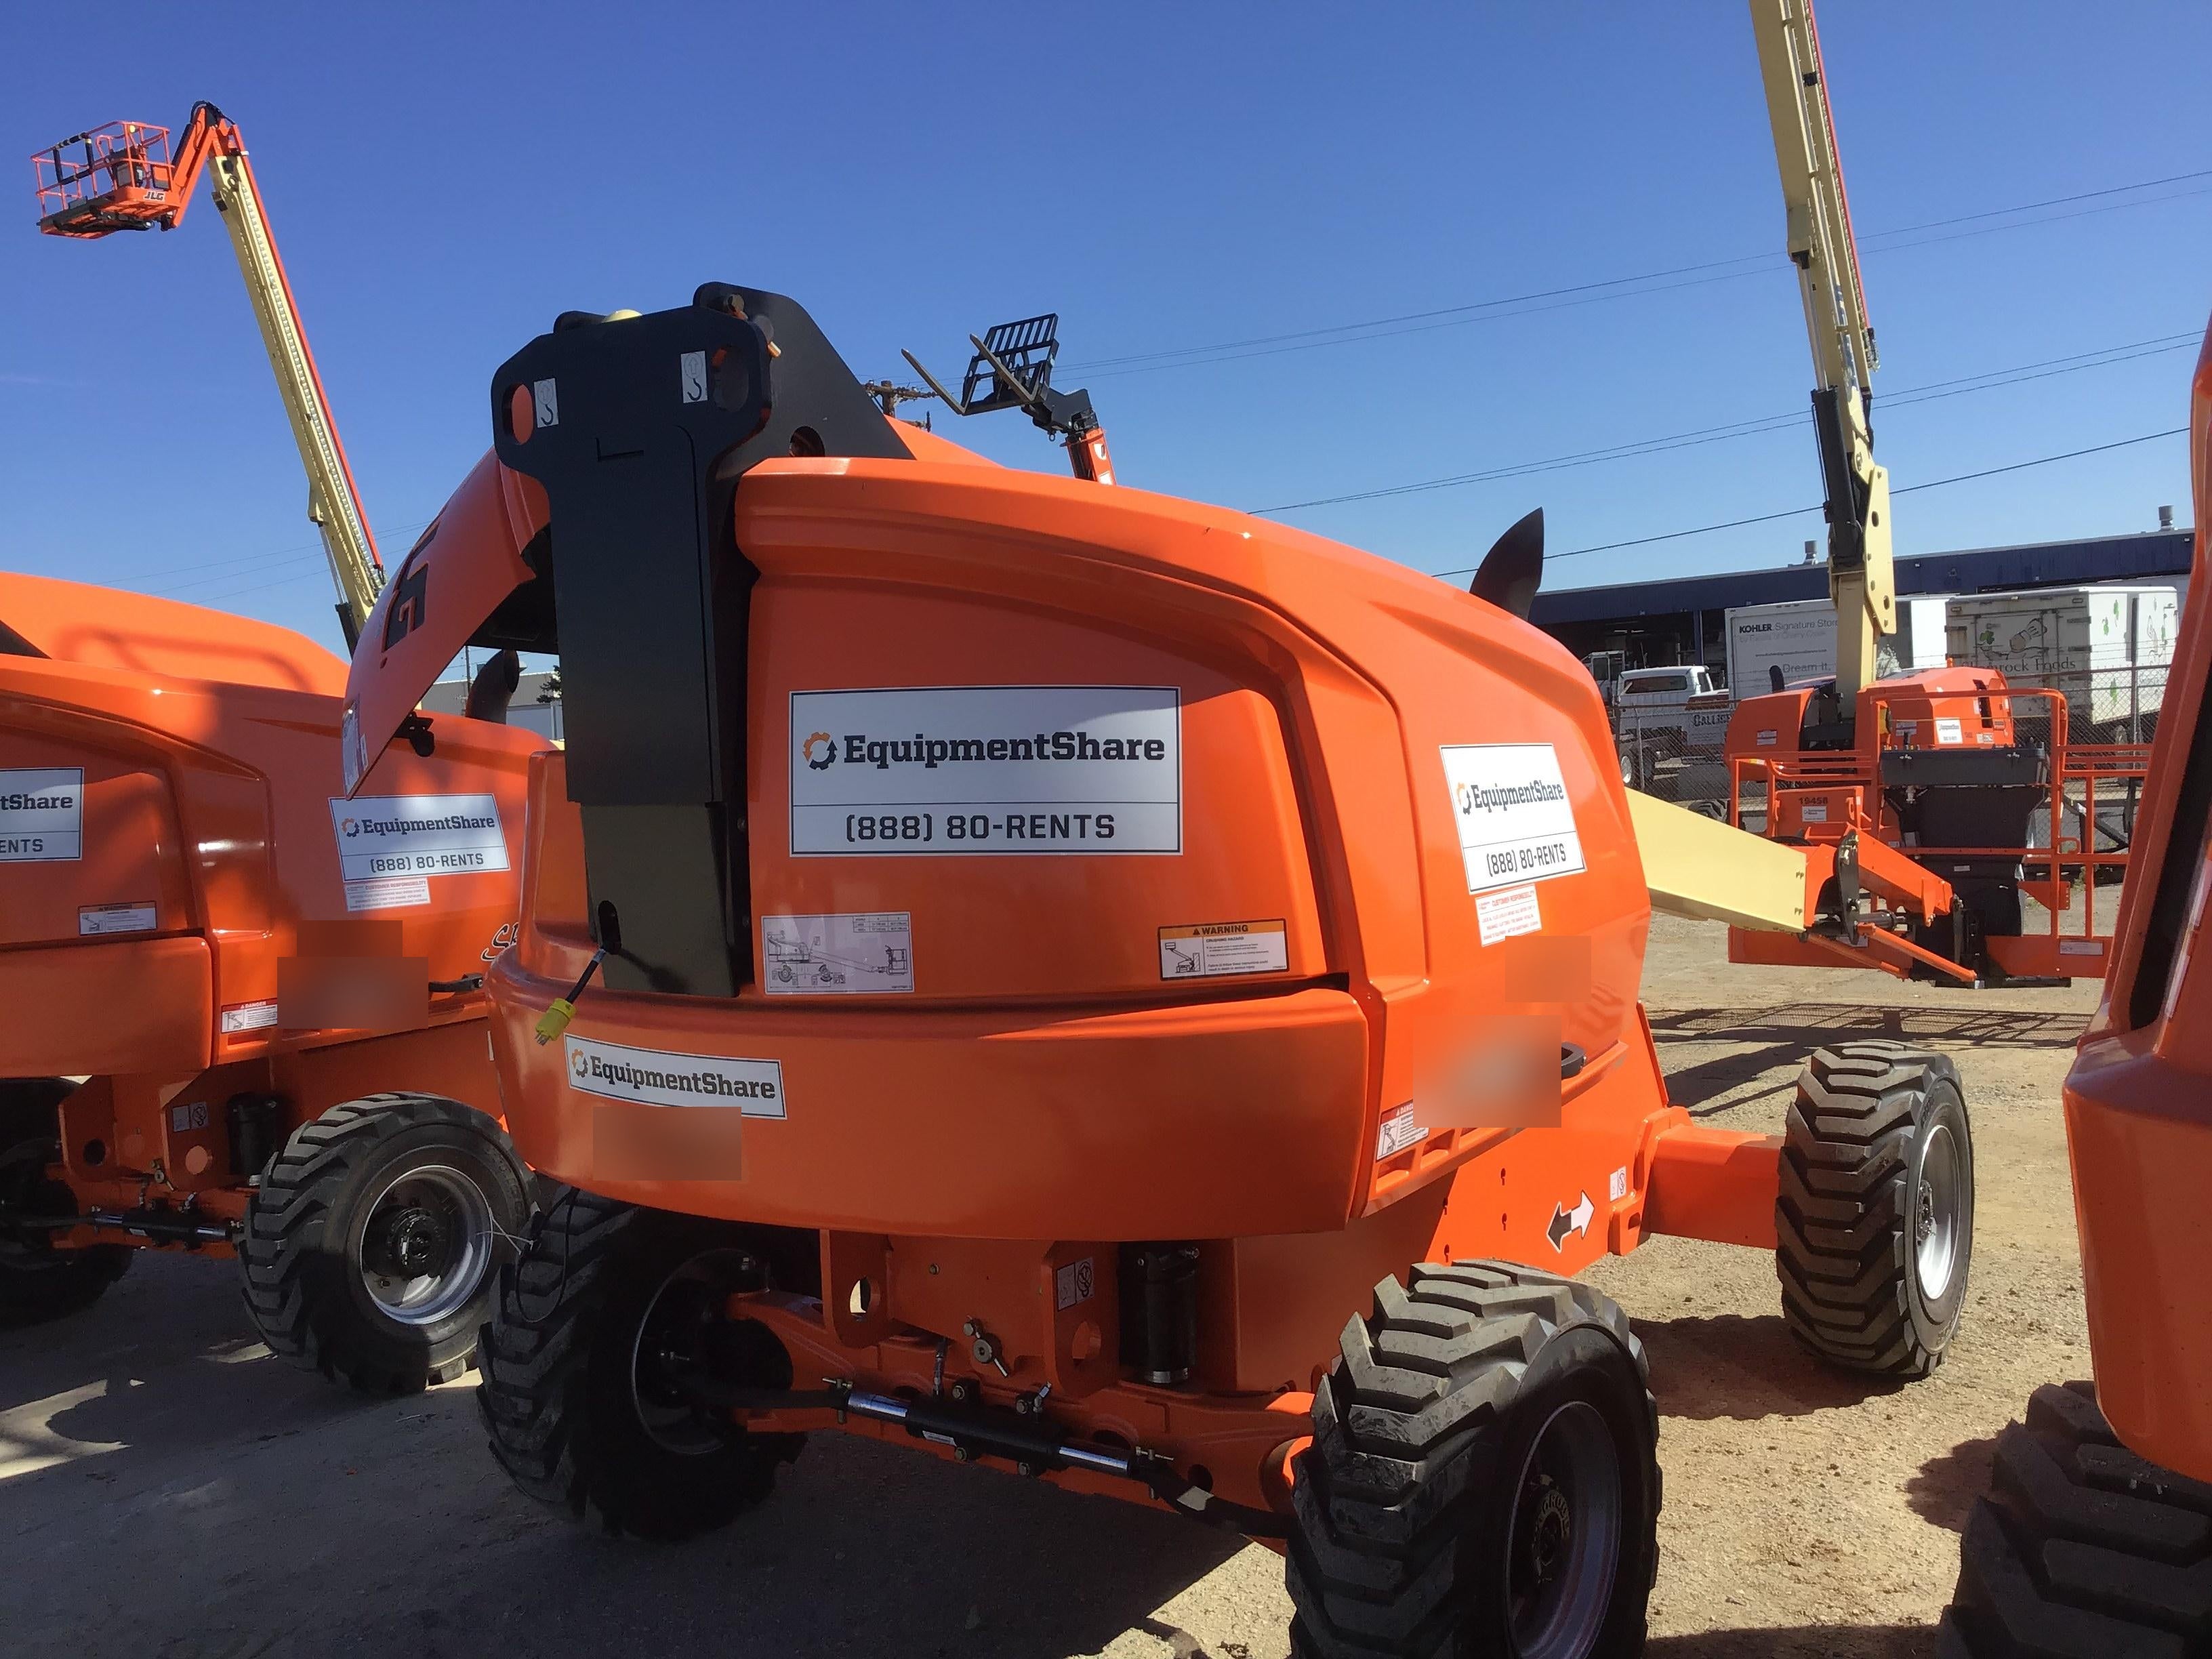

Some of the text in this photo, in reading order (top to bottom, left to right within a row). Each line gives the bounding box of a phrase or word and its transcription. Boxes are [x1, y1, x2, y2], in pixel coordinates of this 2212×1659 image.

[144, 191, 164, 201] JLG
[1739, 623, 1772, 633] KOHLER
[1775, 621, 1815, 631] Signature
[1783, 664, 1818, 673] Dream
[2036, 657, 2076, 672] Foods
[844, 732, 1166, 769] EquipmentShare
[1471, 779, 1564, 813] EquipmentShare
[362, 815, 495, 836] EquipmentShare
[846, 813, 1115, 842] (888) 80-RENTS
[370, 853, 484, 873] (888) 80-RENTS
[1486, 843, 1566, 877] (888) 80-RENTS
[1202, 924, 1248, 935] WARNING
[590, 1055, 776, 1100] EquipmentShare
